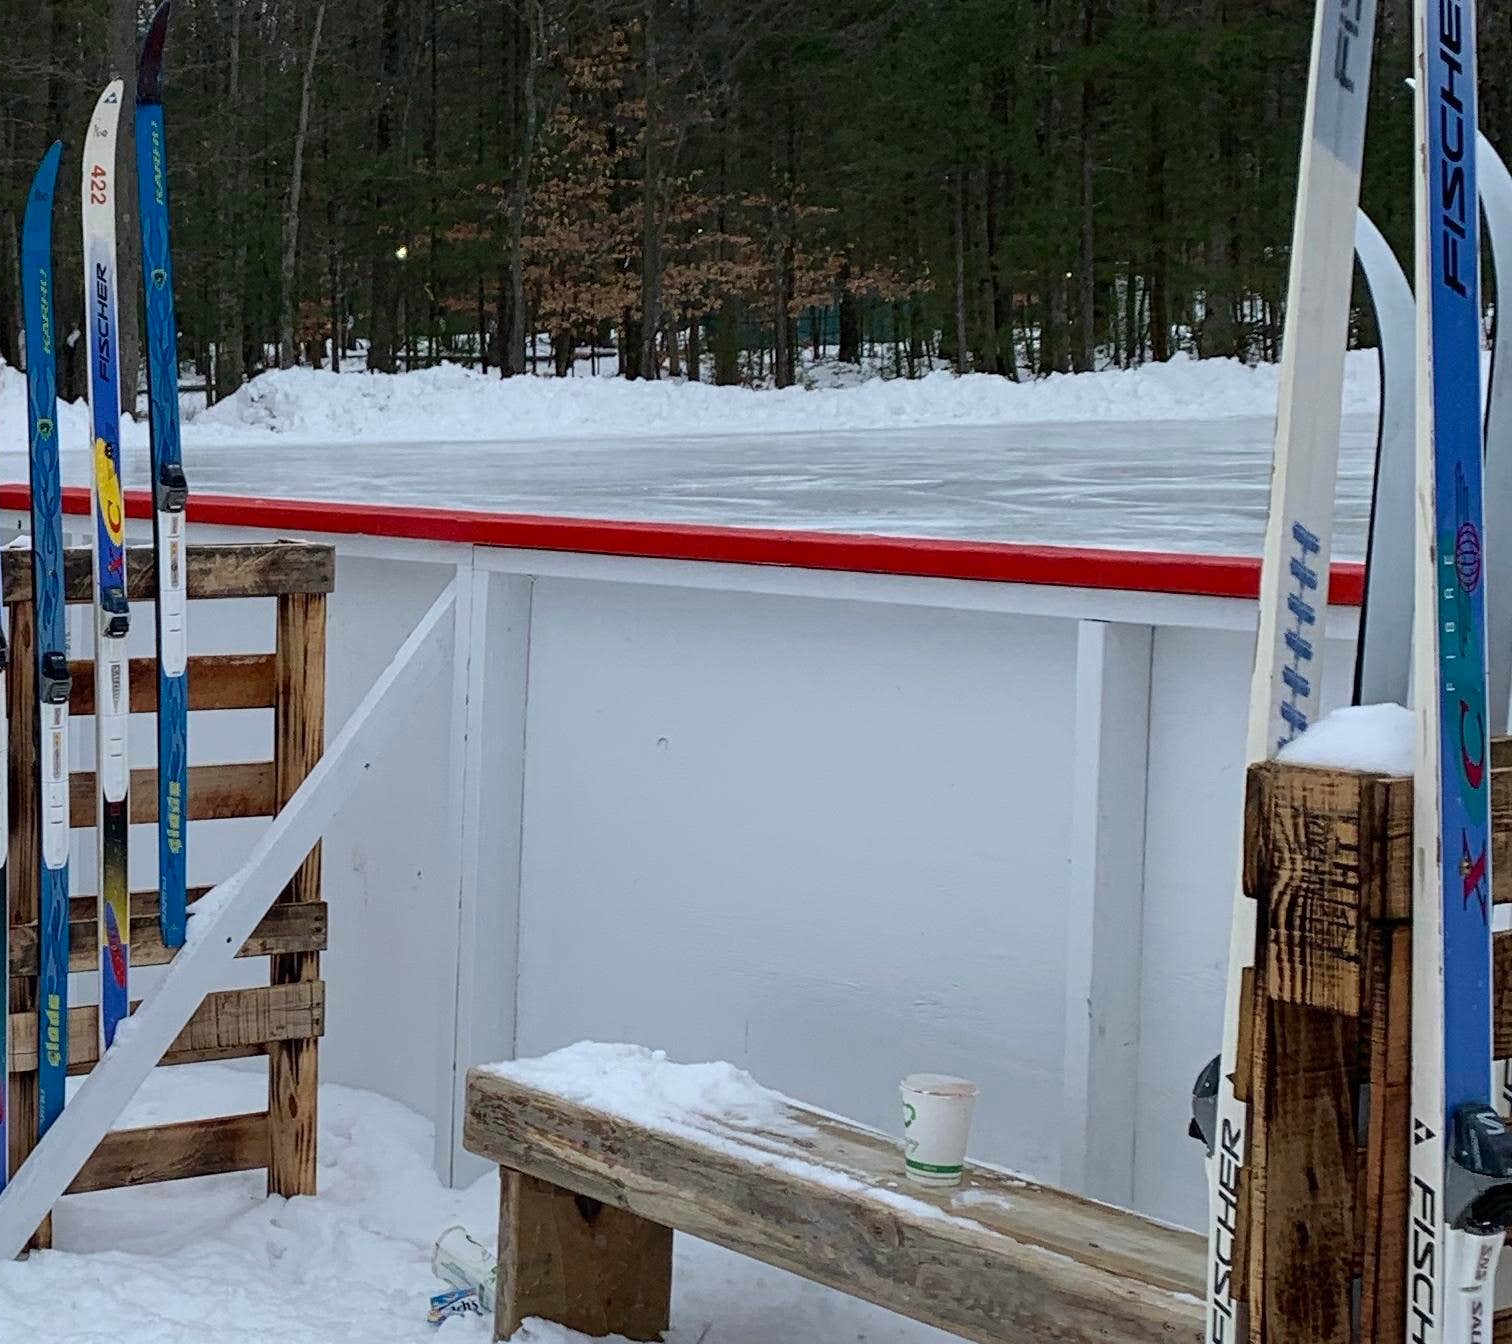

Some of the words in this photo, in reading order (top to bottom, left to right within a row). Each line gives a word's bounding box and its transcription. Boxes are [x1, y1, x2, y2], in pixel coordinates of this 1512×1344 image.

[91, 164, 106, 205] 422
[96, 263, 111, 383] FISCHER
[1443, 554, 1456, 692] FIBRE
[45, 994, 61, 1068] glade
